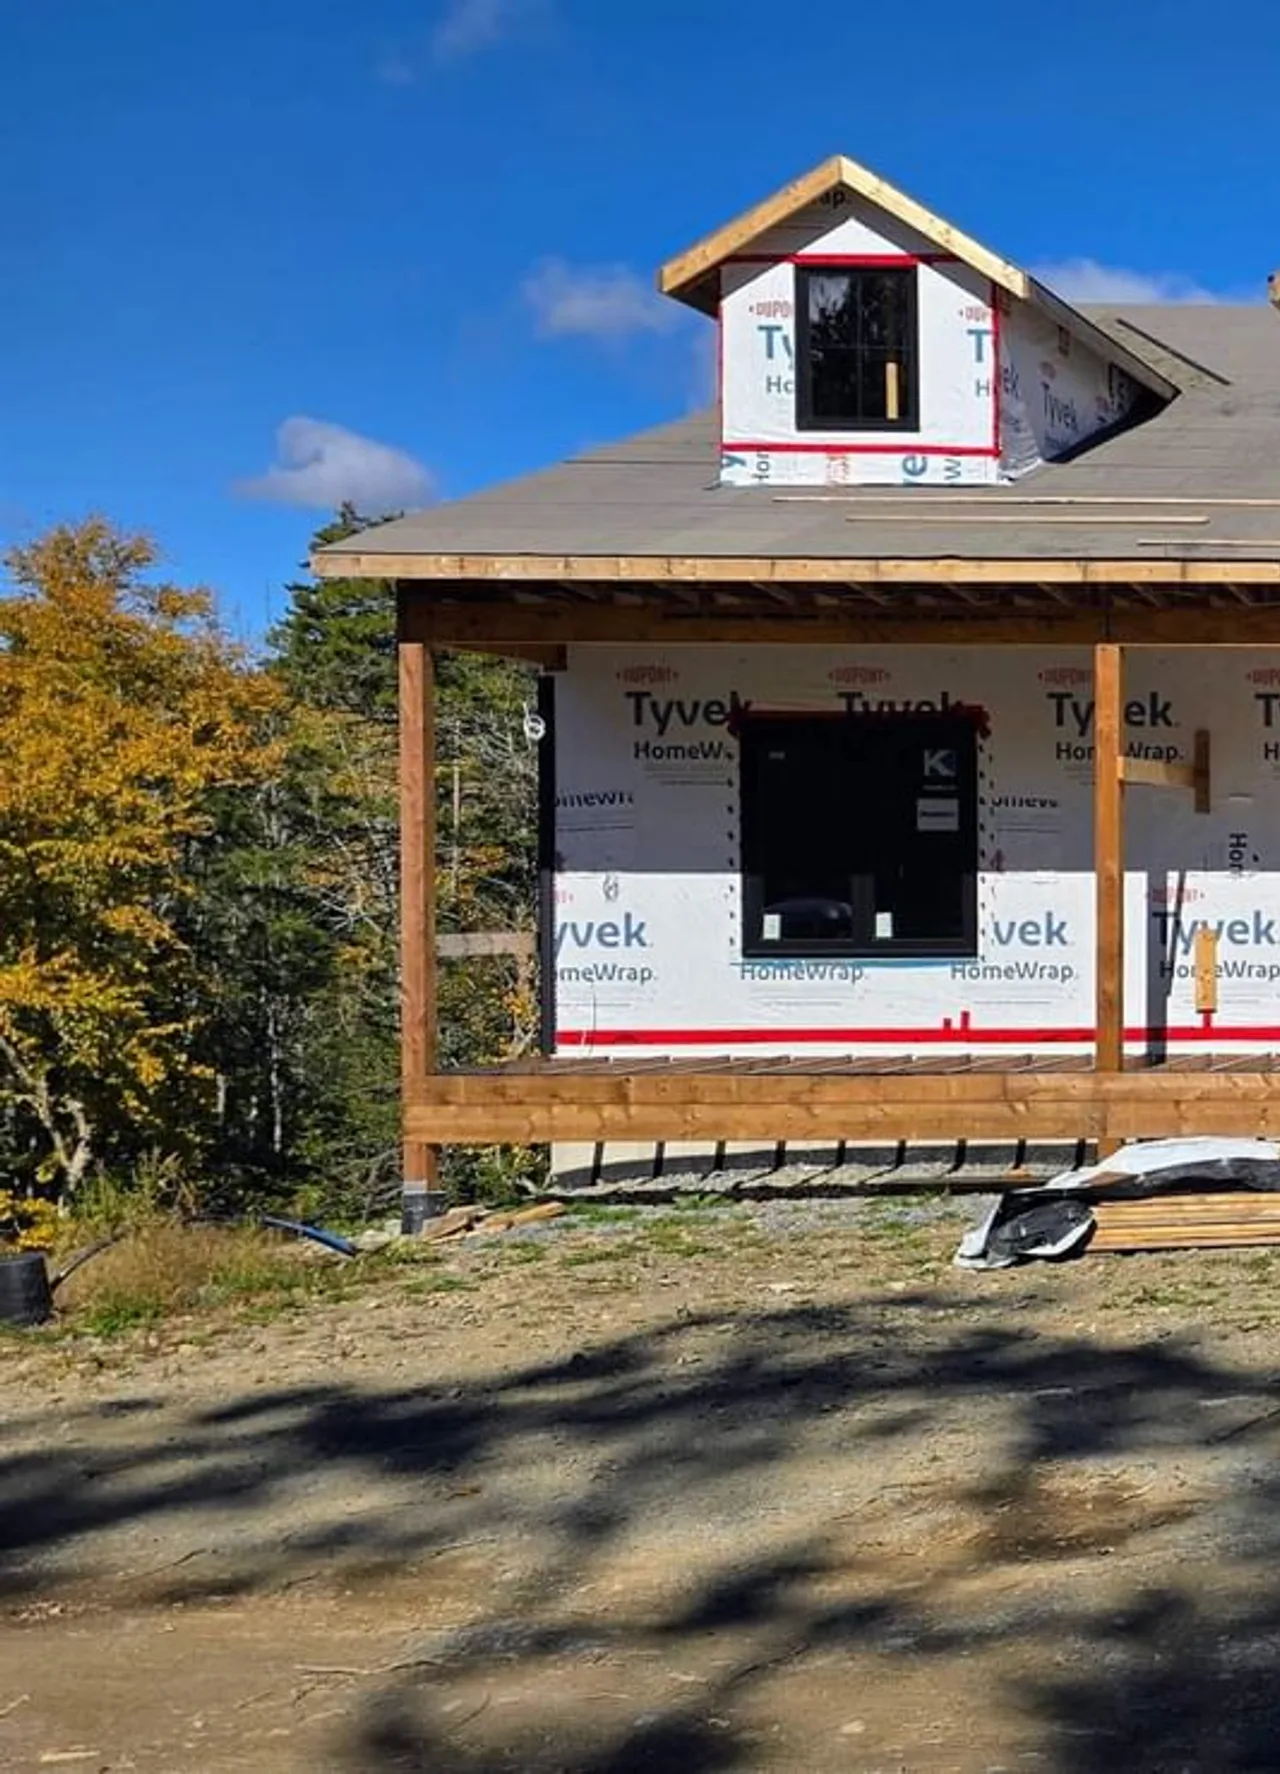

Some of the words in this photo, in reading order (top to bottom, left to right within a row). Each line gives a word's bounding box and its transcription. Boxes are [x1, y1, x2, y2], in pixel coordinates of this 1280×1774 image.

[1047, 691, 1174, 737] Tyek
[633, 741, 724, 760] HomeW
[1056, 742, 1178, 763] HoWrap
[555, 911, 648, 958] yvek
[993, 911, 1068, 947] vek
[559, 964, 652, 984] meWrap
[740, 961, 864, 982] HomeWrap
[950, 960, 1074, 983] HomeWrap
[1160, 960, 1280, 982] HoeWrap
